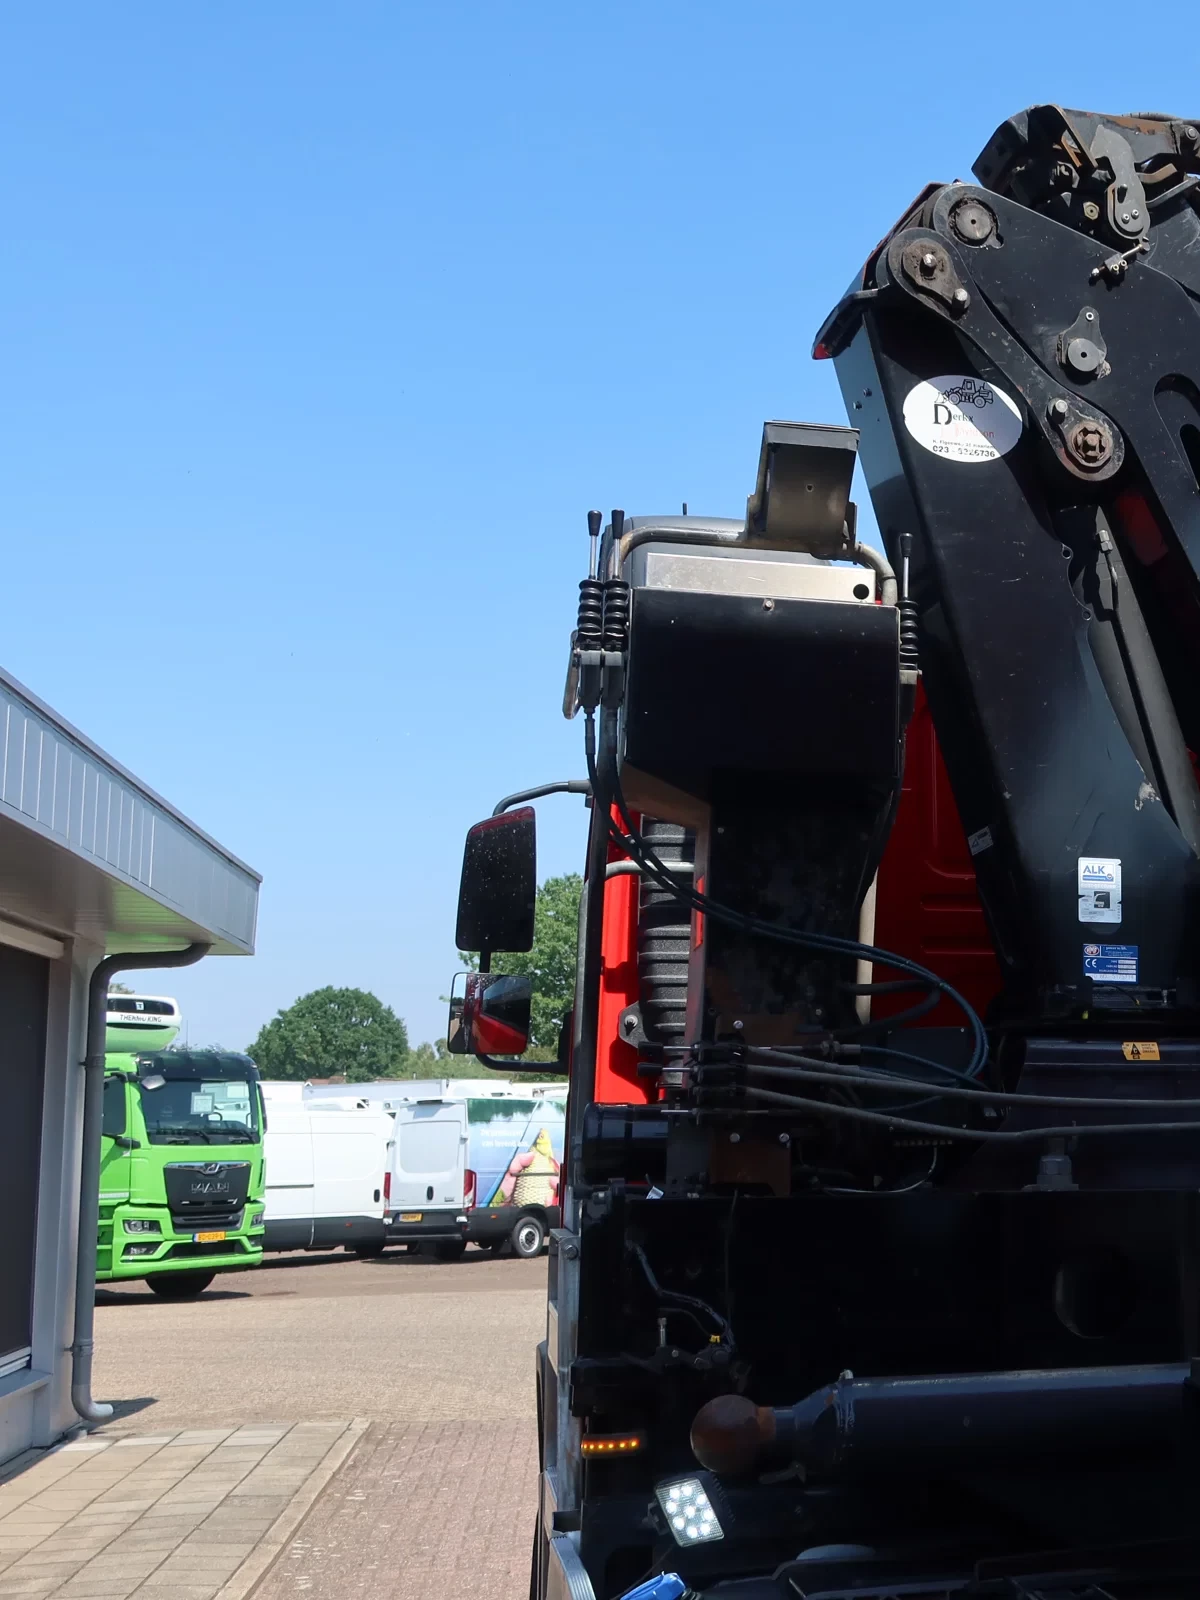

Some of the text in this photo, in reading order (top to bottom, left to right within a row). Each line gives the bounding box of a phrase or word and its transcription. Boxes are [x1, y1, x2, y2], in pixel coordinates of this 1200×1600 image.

[932, 404, 974, 426] Derkx
[1082, 865, 1106, 875] ALK
[191, 1182, 230, 1194] MAN
